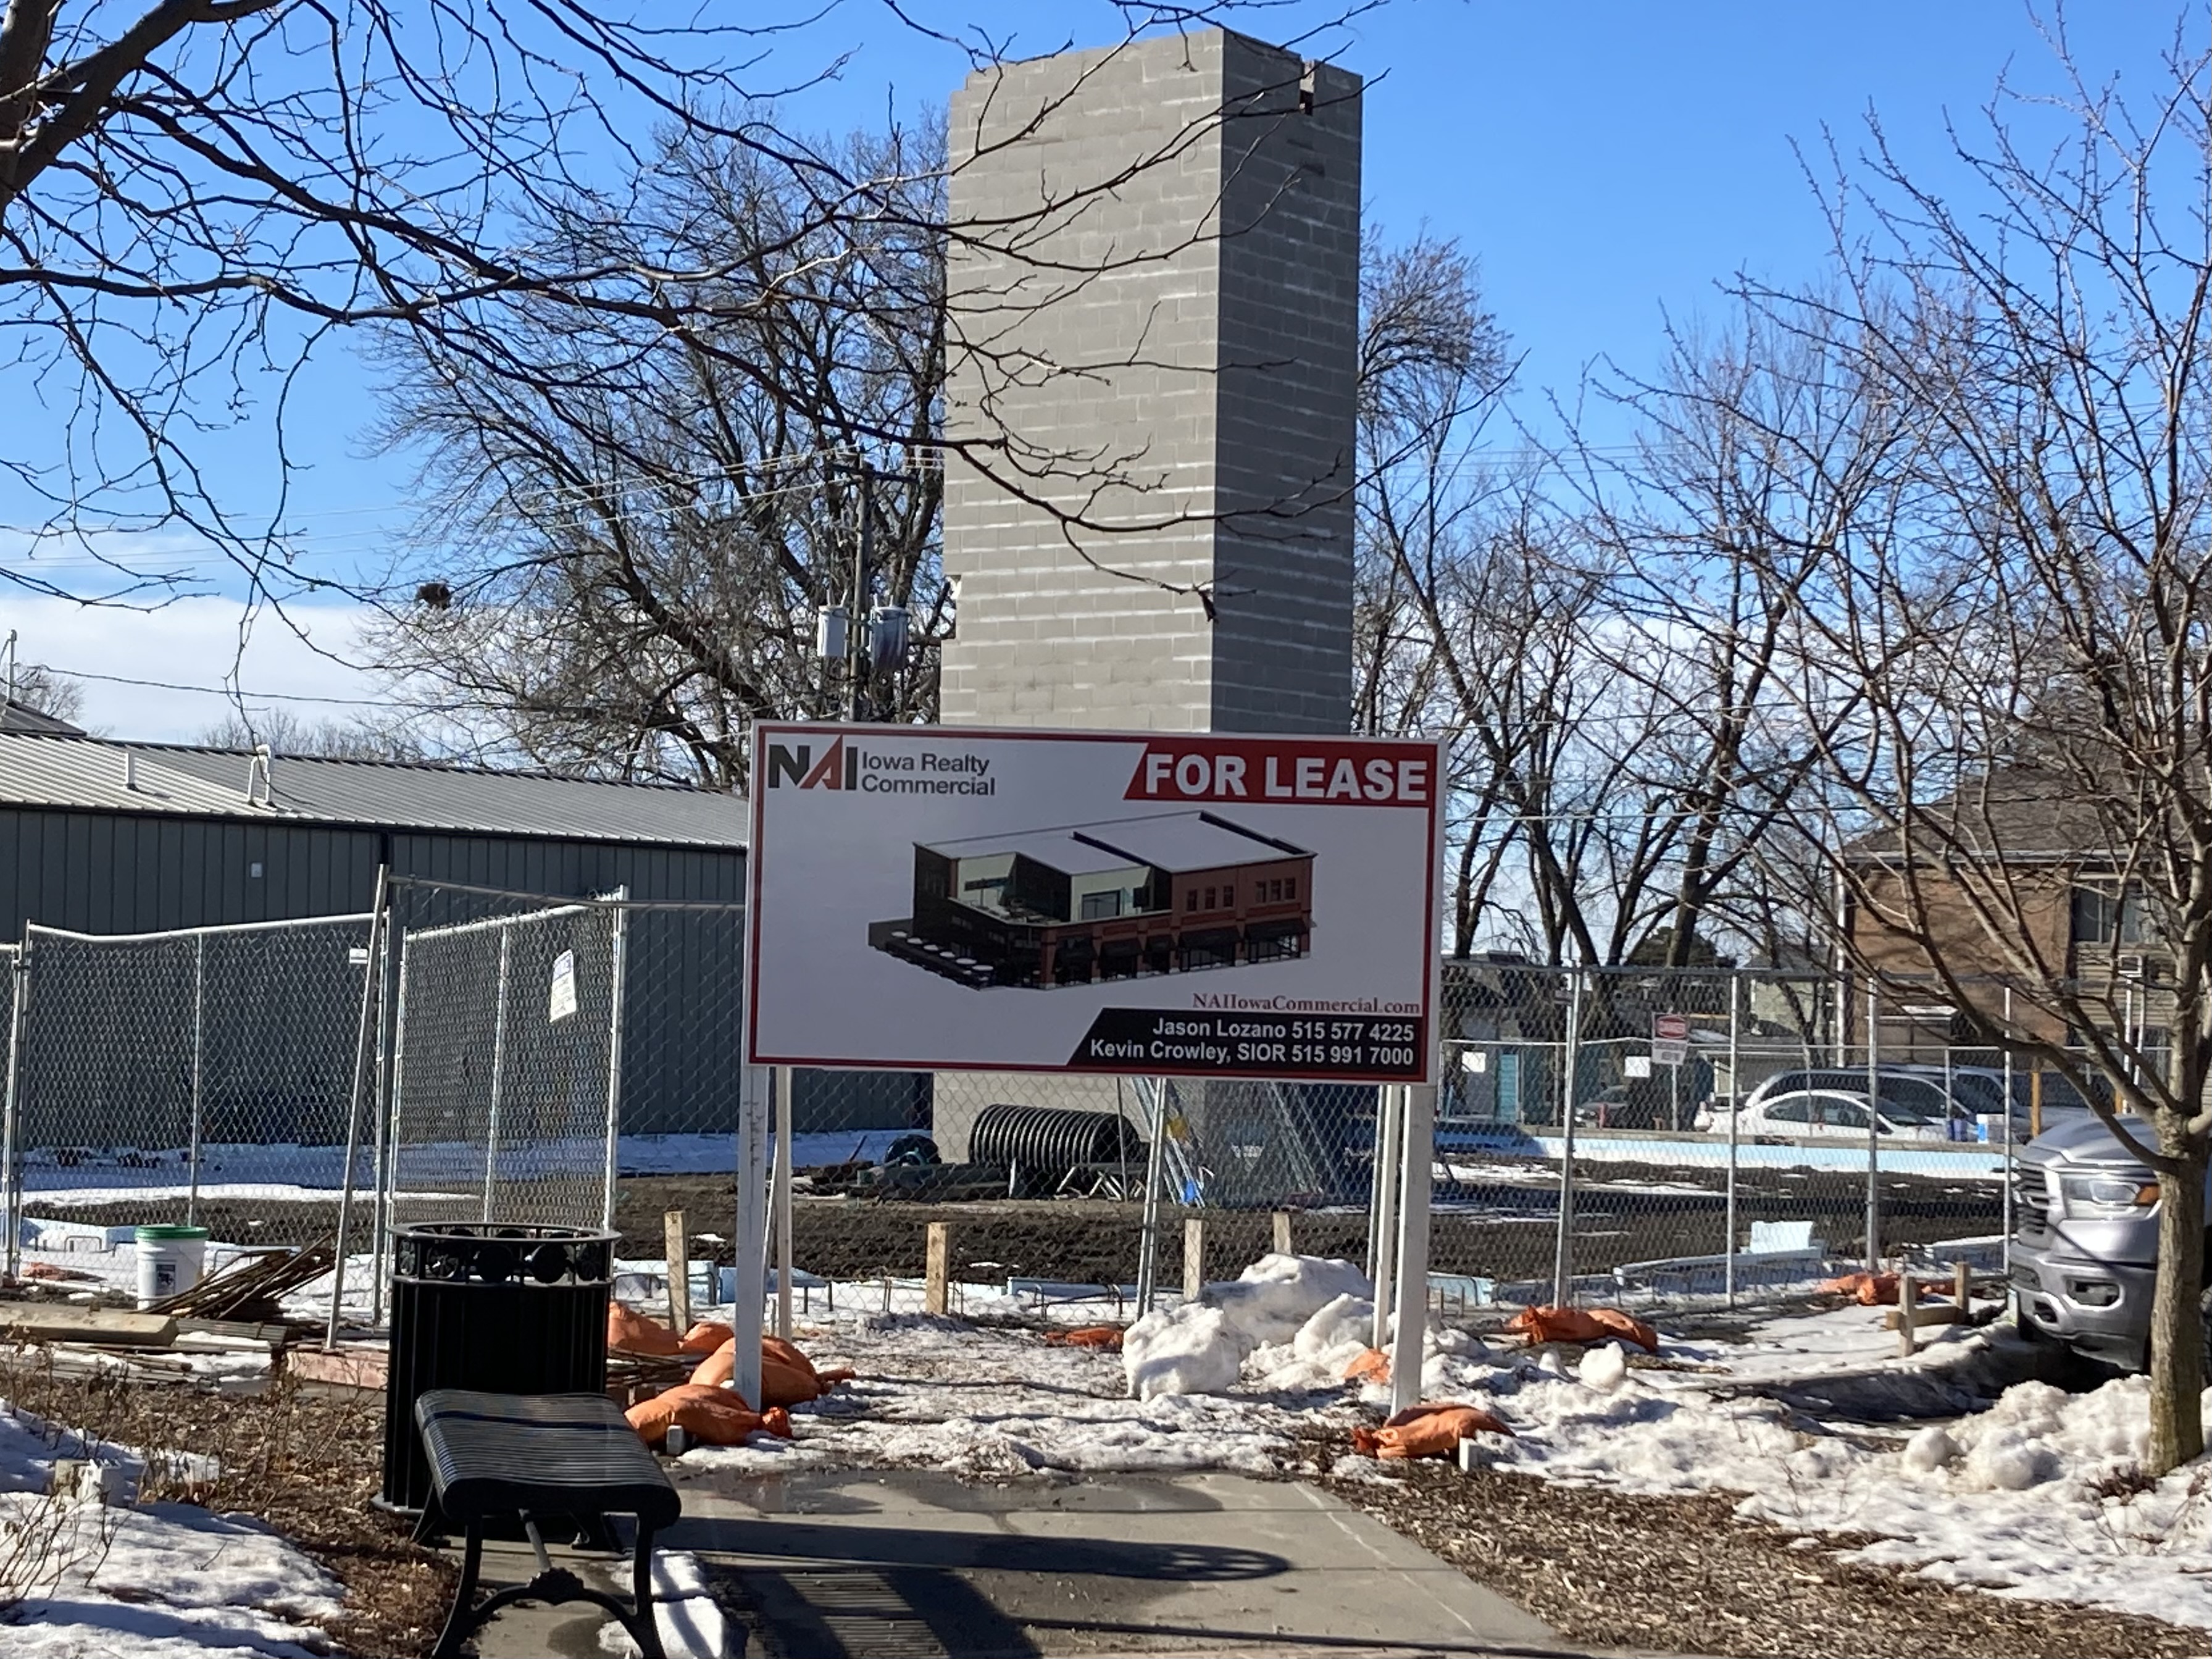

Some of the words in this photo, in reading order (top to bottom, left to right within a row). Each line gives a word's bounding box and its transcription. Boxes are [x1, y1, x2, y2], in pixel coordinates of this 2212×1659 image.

[767, 733, 858, 791] NAI
[862, 751, 915, 771] Iowa
[921, 753, 990, 777] Realty
[861, 774, 996, 796] Commercial
[1145, 753, 1248, 797] FOR
[1264, 756, 1427, 801] LEASE
[1192, 993, 1420, 1014] NAIIowaCommercial.com
[1152, 1017, 1211, 1036] Jason
[1216, 1019, 1287, 1038] Lozano
[1291, 1021, 1325, 1040] 515
[1330, 1022, 1364, 1040] 577
[1368, 1024, 1415, 1042] 4225
[1090, 1038, 1144, 1058] Kevin
[1150, 1040, 1232, 1065] Crowley,
[1236, 1043, 1286, 1062] SIOR
[1291, 1045, 1325, 1063] 515
[1330, 1046, 1362, 1064] 991
[1369, 1047, 1414, 1066] 7000
